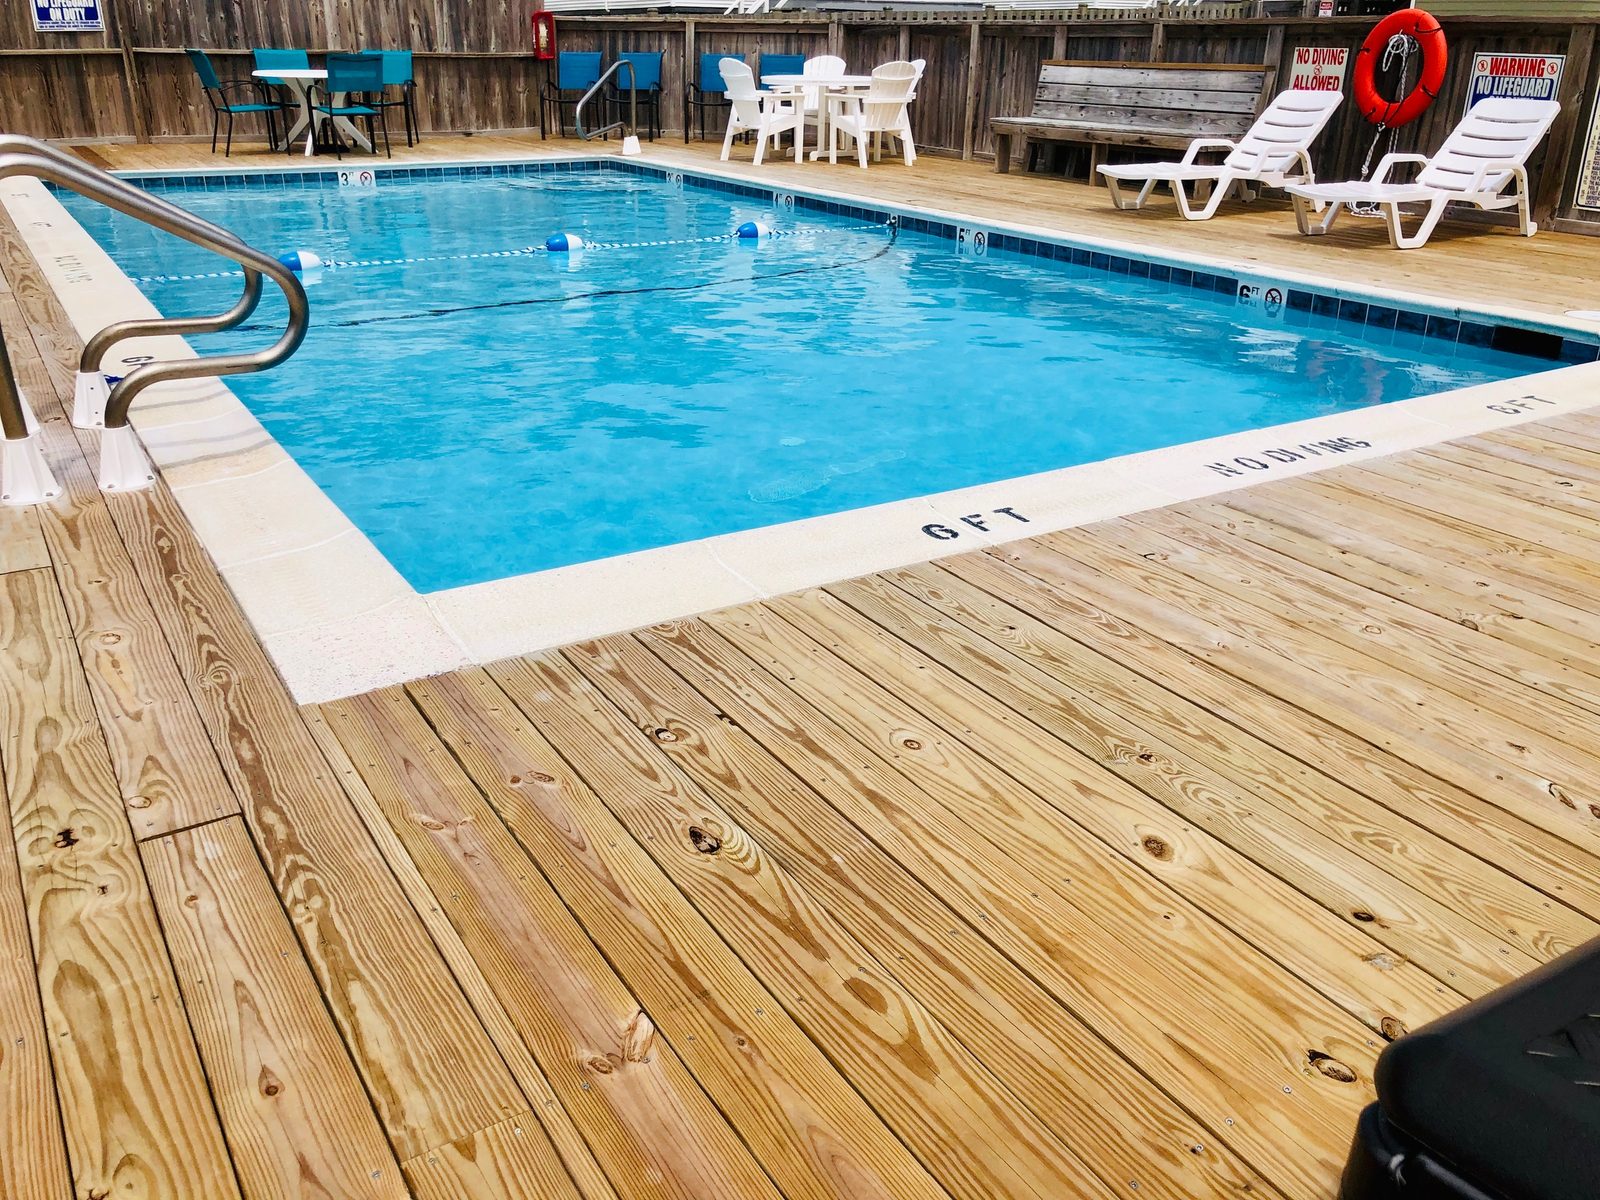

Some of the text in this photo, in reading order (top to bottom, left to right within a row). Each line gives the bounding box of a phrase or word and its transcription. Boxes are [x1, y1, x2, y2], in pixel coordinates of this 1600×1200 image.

[49, 8, 85, 21] ON DUTY
[1296, 48, 1345, 65] NO DIVING
[1489, 57, 1546, 77] WARNING
[1293, 74, 1340, 91] ALLOWED
[1476, 76, 1551, 98] NO LIFEGUARD
[1261, 436, 1372, 463] DIVING
